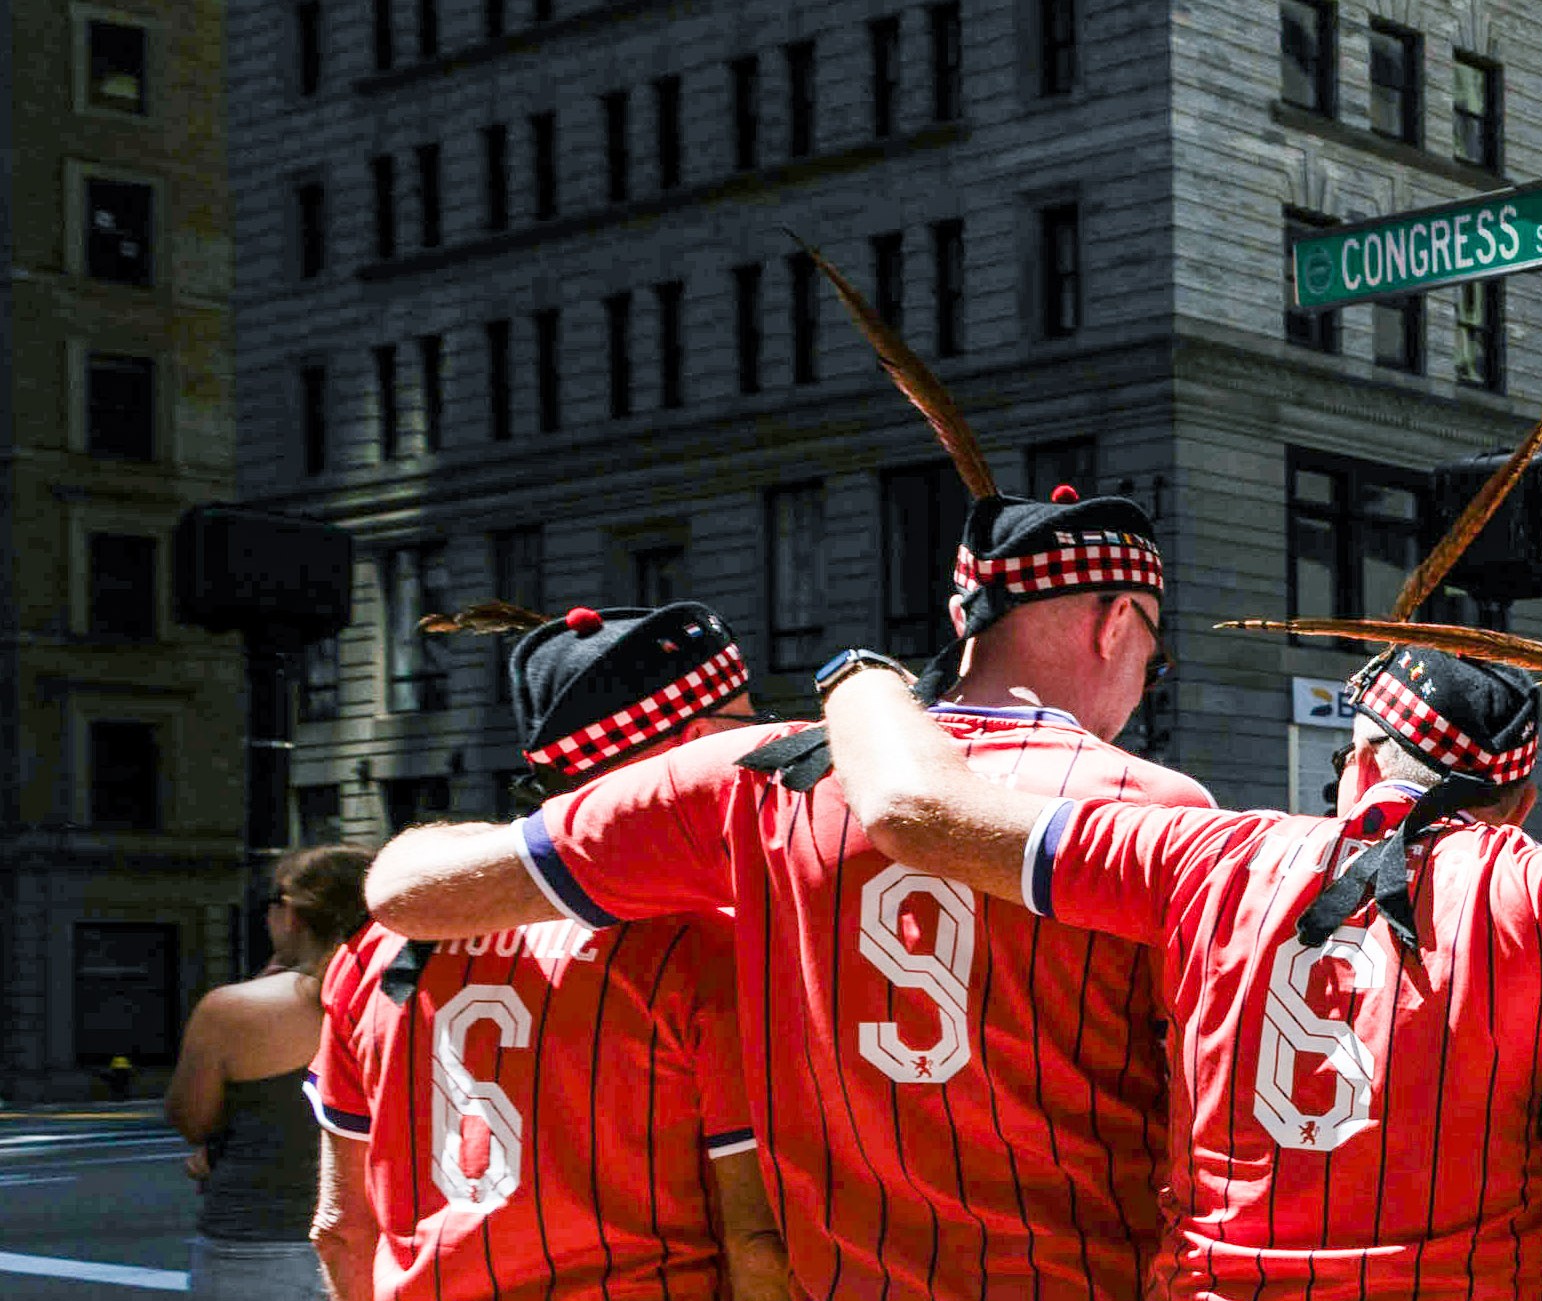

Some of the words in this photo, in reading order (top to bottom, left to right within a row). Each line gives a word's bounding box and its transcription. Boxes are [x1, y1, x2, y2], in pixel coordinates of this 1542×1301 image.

[1342, 204, 1519, 290] CONGRESS
[859, 862, 975, 1084] 9
[1253, 924, 1388, 1152] 6
[432, 984, 532, 1213] 6
